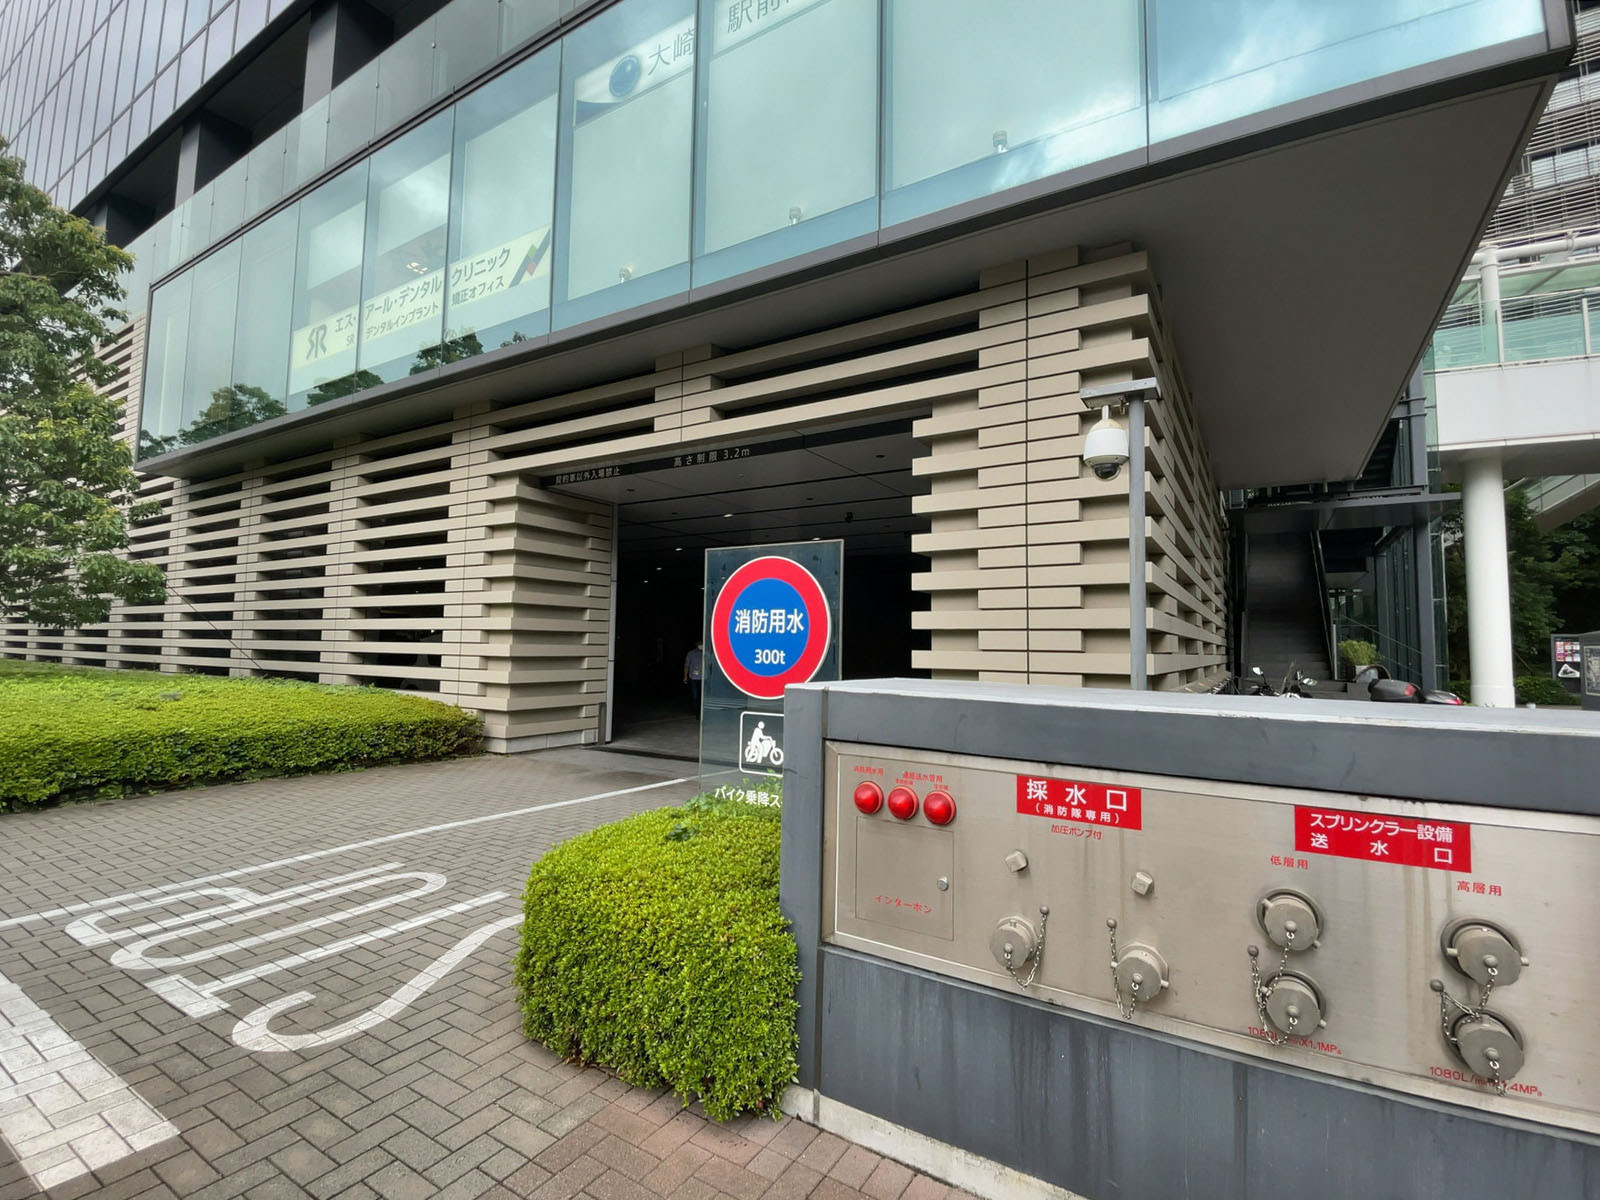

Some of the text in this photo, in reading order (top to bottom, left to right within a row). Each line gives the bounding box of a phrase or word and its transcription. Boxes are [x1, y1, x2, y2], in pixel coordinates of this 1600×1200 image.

[728, 0, 789, 34] 駅前
[673, 448, 750, 468] 高さ制限 3.2m
[734, 608, 805, 635] 消防用水
[754, 649, 786, 665] 300t
[714, 785, 783, 808] バイク乗降ス
[1026, 778, 1128, 812] 採水口
[1035, 802, 1120, 824] (消防隊専用)
[1051, 824, 1103, 841] 加圧ポンプ付
[1310, 813, 1454, 844] スプリンクラー設備
[1311, 832, 1454, 865] 送水口
[1270, 855, 1309, 870] 低層用
[1456, 880, 1503, 897] 高層用
[875, 895, 933, 915] インターホン
